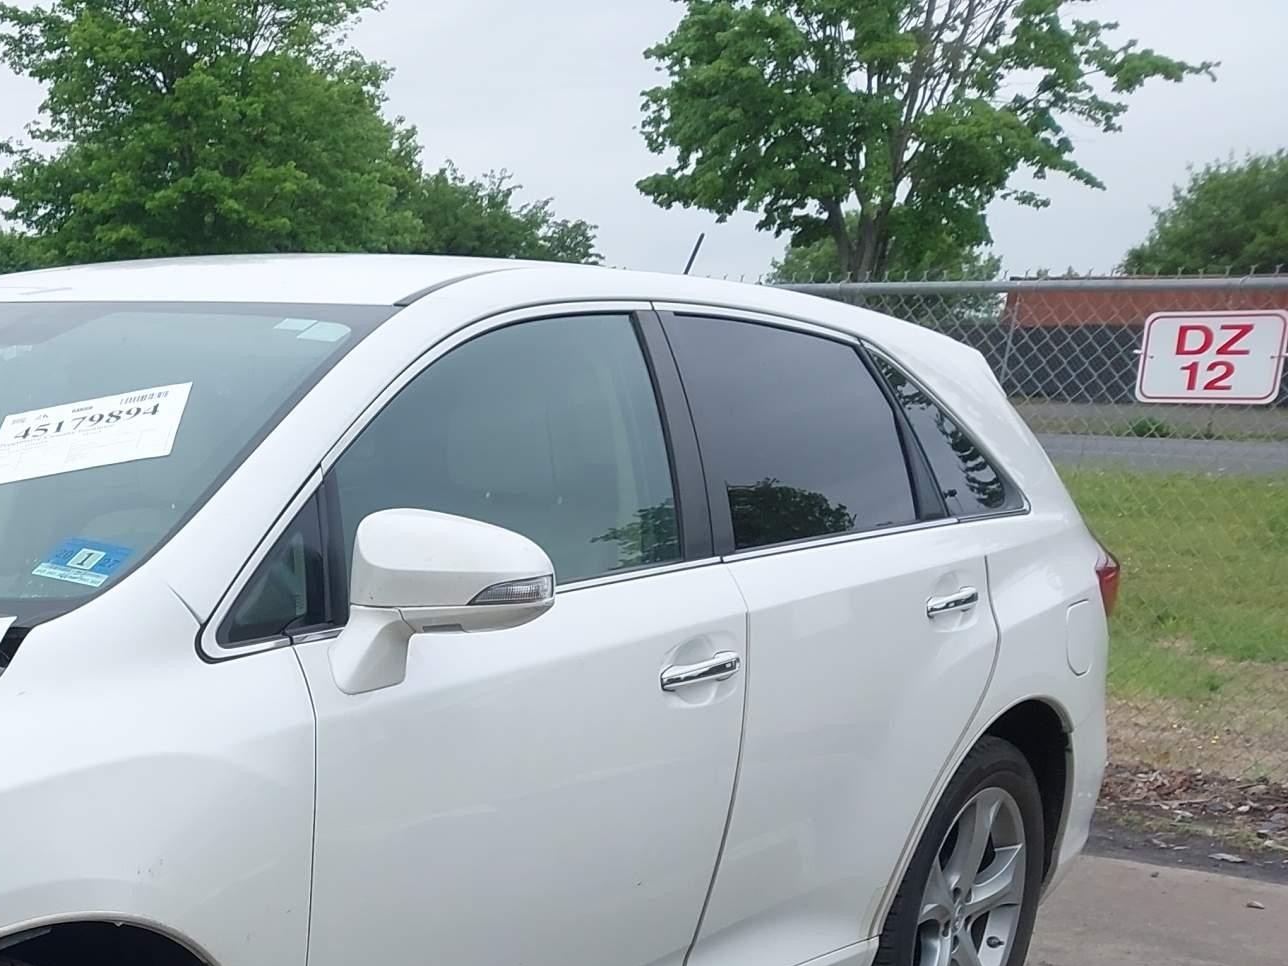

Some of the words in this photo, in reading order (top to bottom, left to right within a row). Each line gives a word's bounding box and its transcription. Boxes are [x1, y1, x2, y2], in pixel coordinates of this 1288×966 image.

[1175, 324, 1255, 355] DZ
[1180, 360, 1235, 390] 12
[14, 403, 160, 440] 45179894
